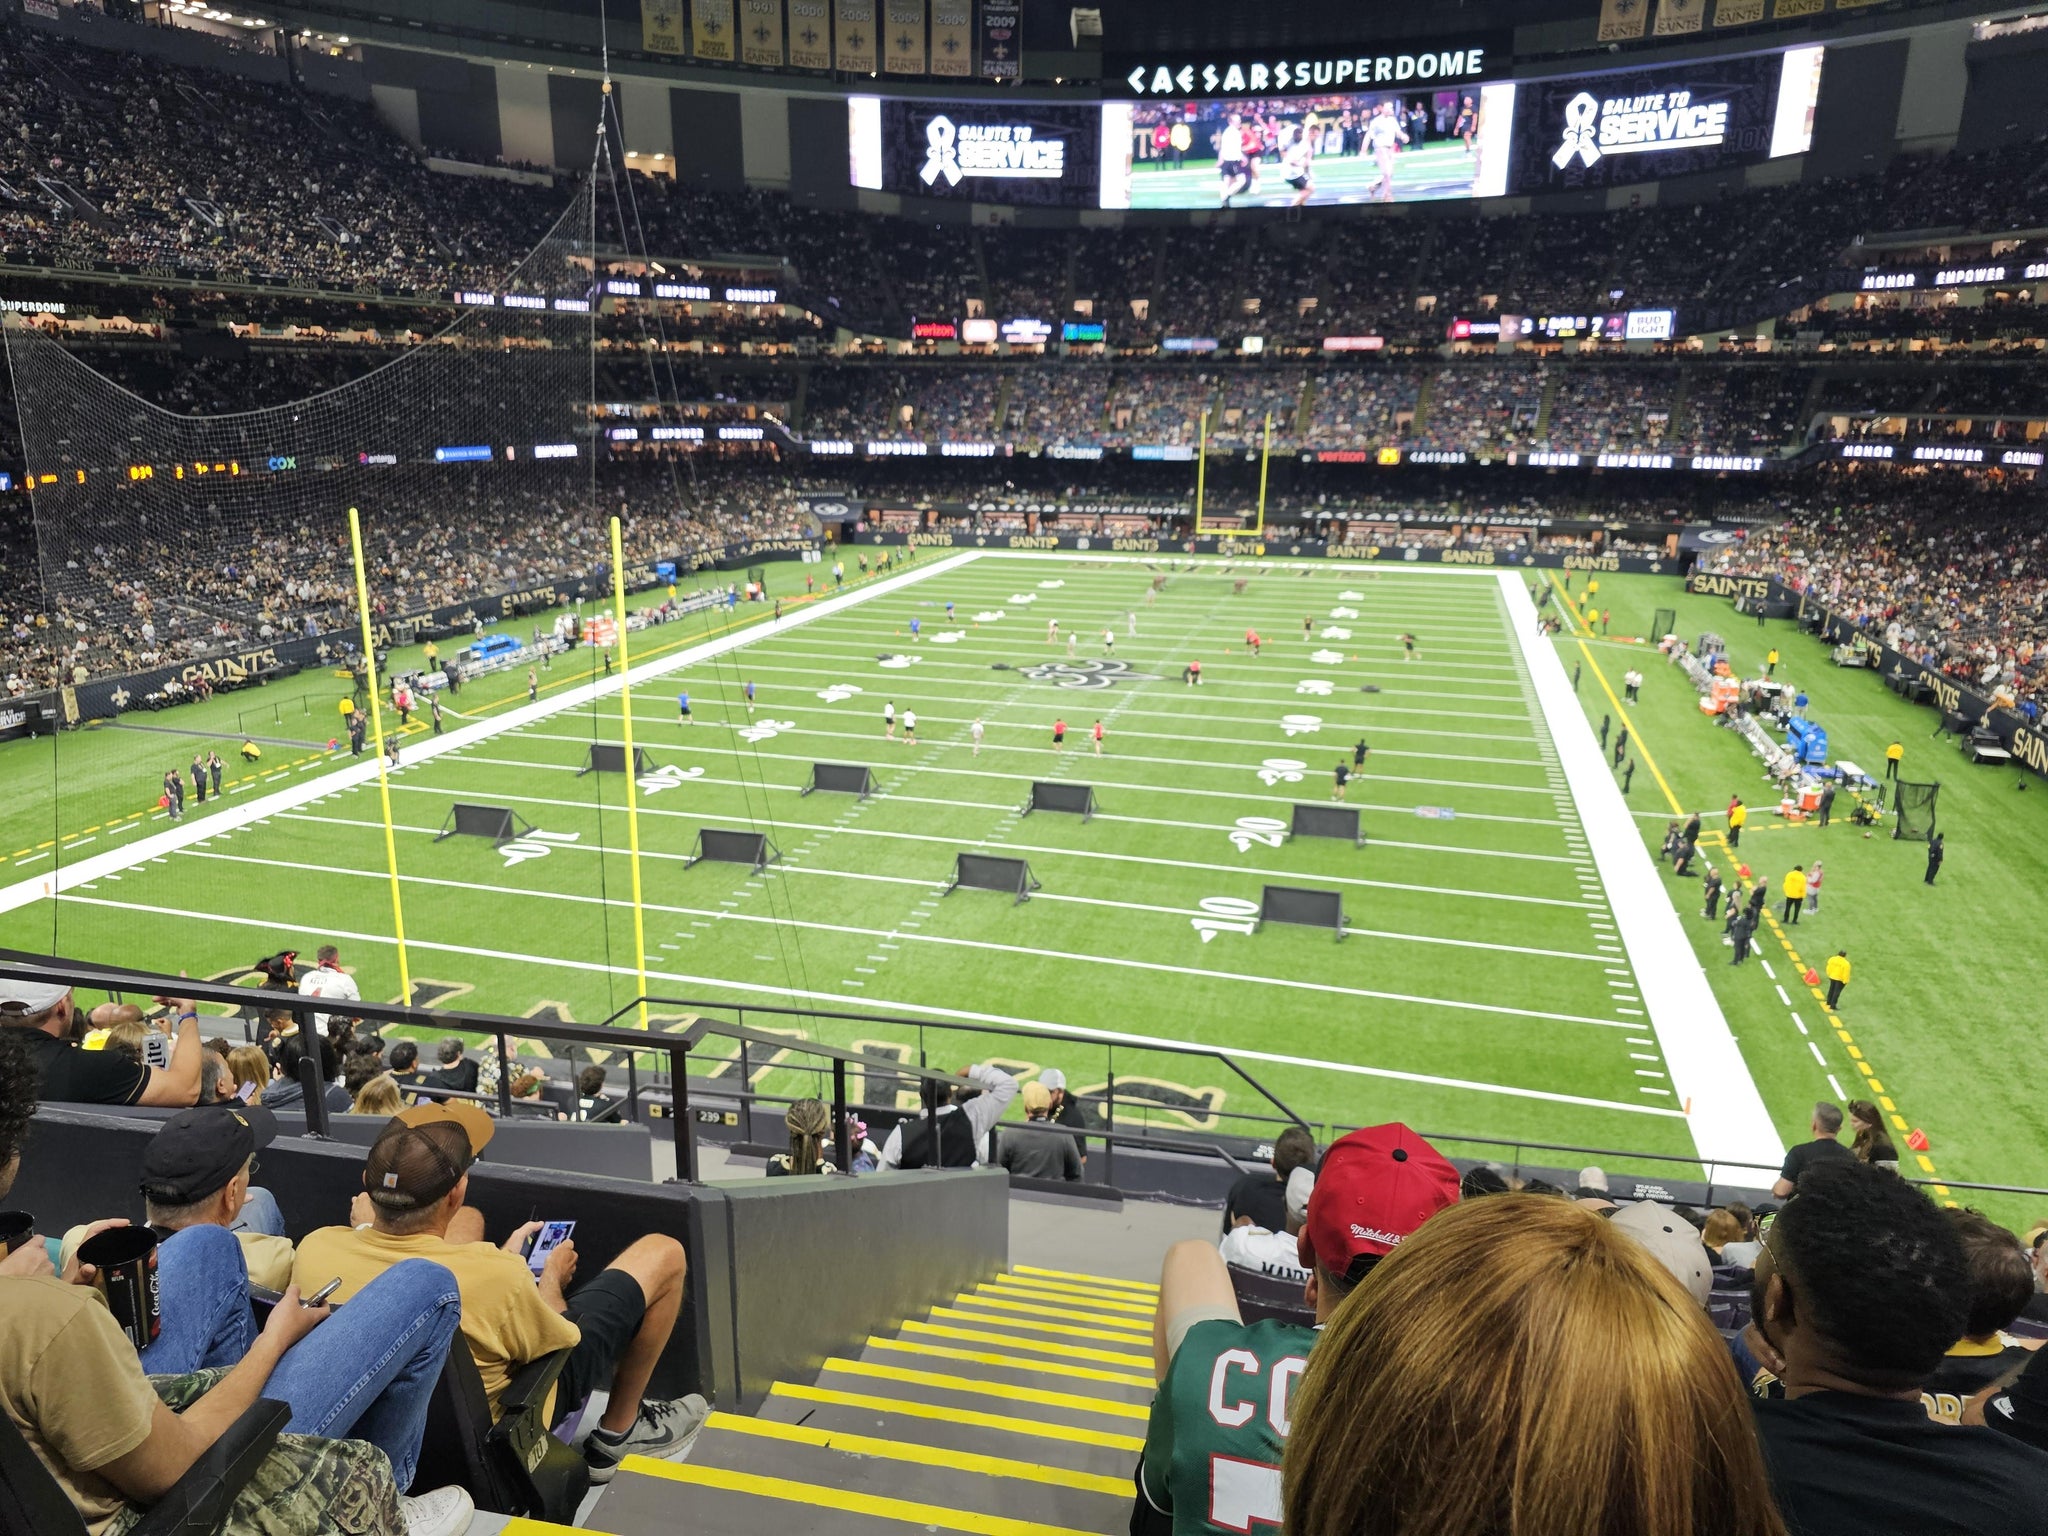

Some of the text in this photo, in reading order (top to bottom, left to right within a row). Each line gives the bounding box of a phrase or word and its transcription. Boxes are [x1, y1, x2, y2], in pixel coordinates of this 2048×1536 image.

[1777, 1, 1823, 16] SAINTS
[986, 15, 1017, 28] 2009
[1716, 10, 1761, 25] SAINTS
[1601, 26, 1642, 39] SAINTS
[1657, 20, 1700, 33] SAINTS
[745, 53, 781, 65] SAINTS
[792, 54, 828, 67] SAINTS
[838, 59, 874, 71] SAINTS
[888, 60, 922, 72] SAINTS
[934, 62, 968, 73] SAINTS
[983, 65, 1018, 76] SAINTS
[1127, 49, 1485, 94] CAESARS SUPERDOME
[1602, 91, 1691, 116] SALUTE TO
[1600, 103, 1729, 145] SERVICE
[958, 125, 1032, 141] SALUTE TO
[958, 140, 1064, 169] SERVICE
[54, 258, 95, 272] SAINTS
[139, 267, 177, 279] SAINTS
[216, 272, 250, 284] SAINTS
[1862, 263, 2048, 290] HONOR EMPOWER CO
[1, 300, 66, 315] SUPERDOME
[1636, 316, 1662, 326] BUD
[914, 323, 955, 337] verizon
[1630, 325, 1665, 336] LIGHT
[368, 454, 397, 465] entergy
[1317, 451, 1366, 463] verizon
[1842, 445, 1895, 459] HONOR
[1912, 447, 1984, 462] EMPOWER
[268, 456, 297, 471] COX
[1528, 453, 1763, 471] HONOR EMPOWER CONNECT
[907, 533, 953, 547] SAINTS
[1112, 537, 1159, 552] SAINTS
[1217, 541, 1265, 556] SINT
[1442, 548, 1495, 565] SAINTS
[1562, 555, 1620, 572] SAINTS
[608, 565, 650, 588] SINTS
[1694, 572, 1769, 600] SAINTS
[636, 763, 706, 789] 20
[1229, 816, 1288, 849] 20
[498, 828, 582, 860] 10
[1190, 896, 1260, 937] 10
[147, 1042, 167, 1069] Lite
[700, 1110, 721, 1123] 239
[1350, 1223, 1393, 1242] Mitchell
